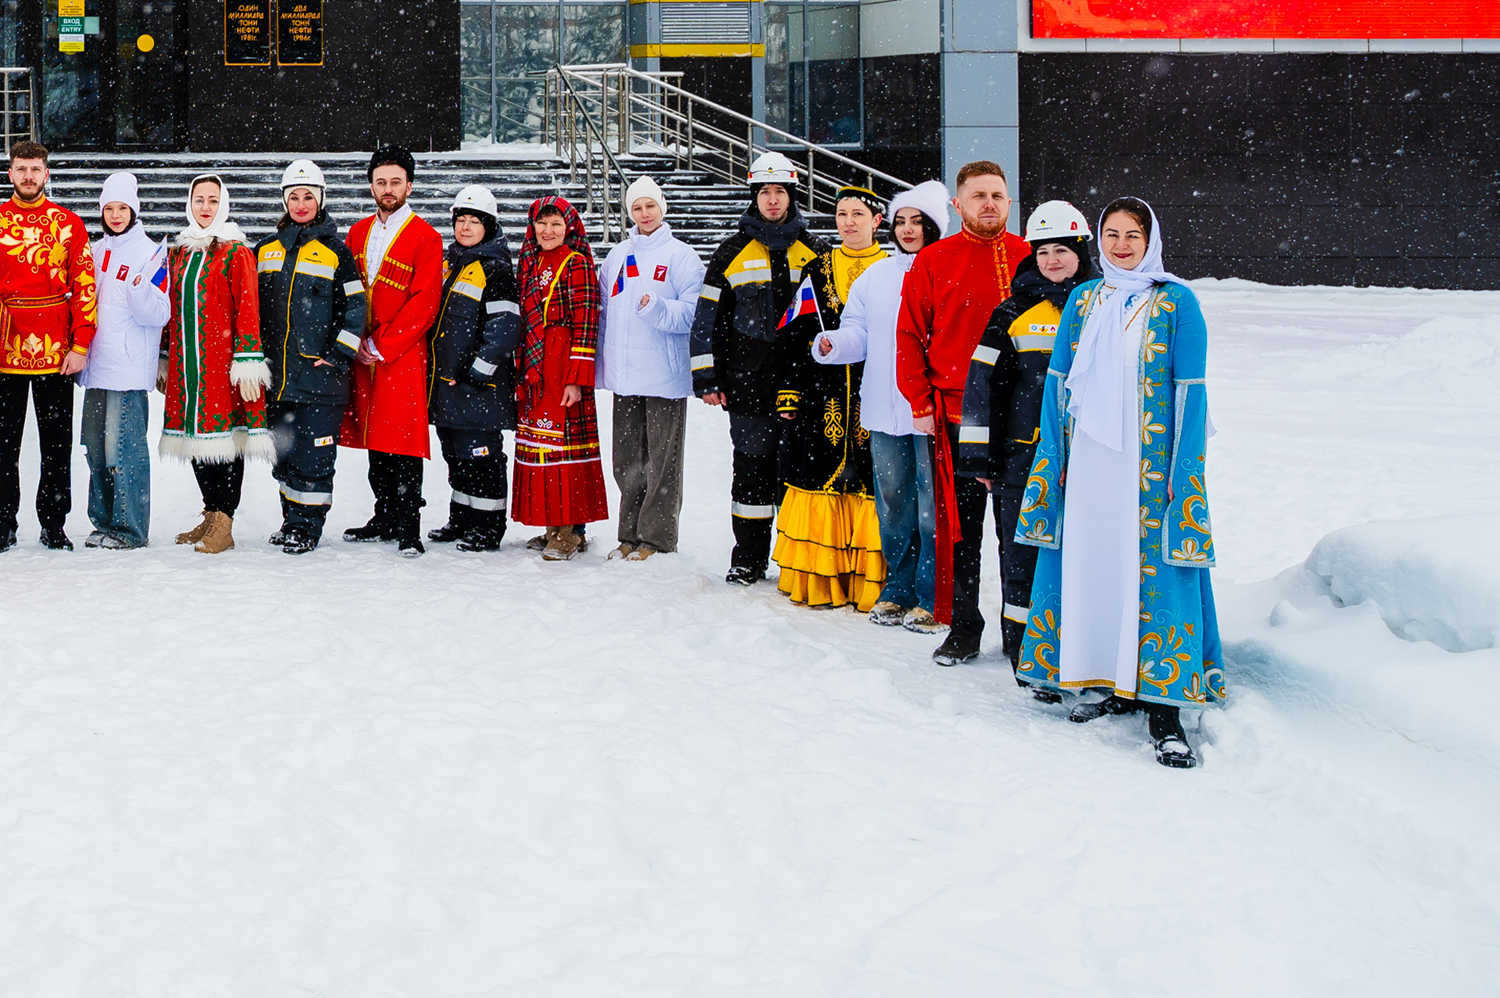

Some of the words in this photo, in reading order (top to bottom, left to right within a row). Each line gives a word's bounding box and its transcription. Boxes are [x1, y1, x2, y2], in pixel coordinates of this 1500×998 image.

[238, 4, 259, 12] ОДИН
[239, 19, 258, 27] ТОНН
[291, 19, 311, 27] ТОНН
